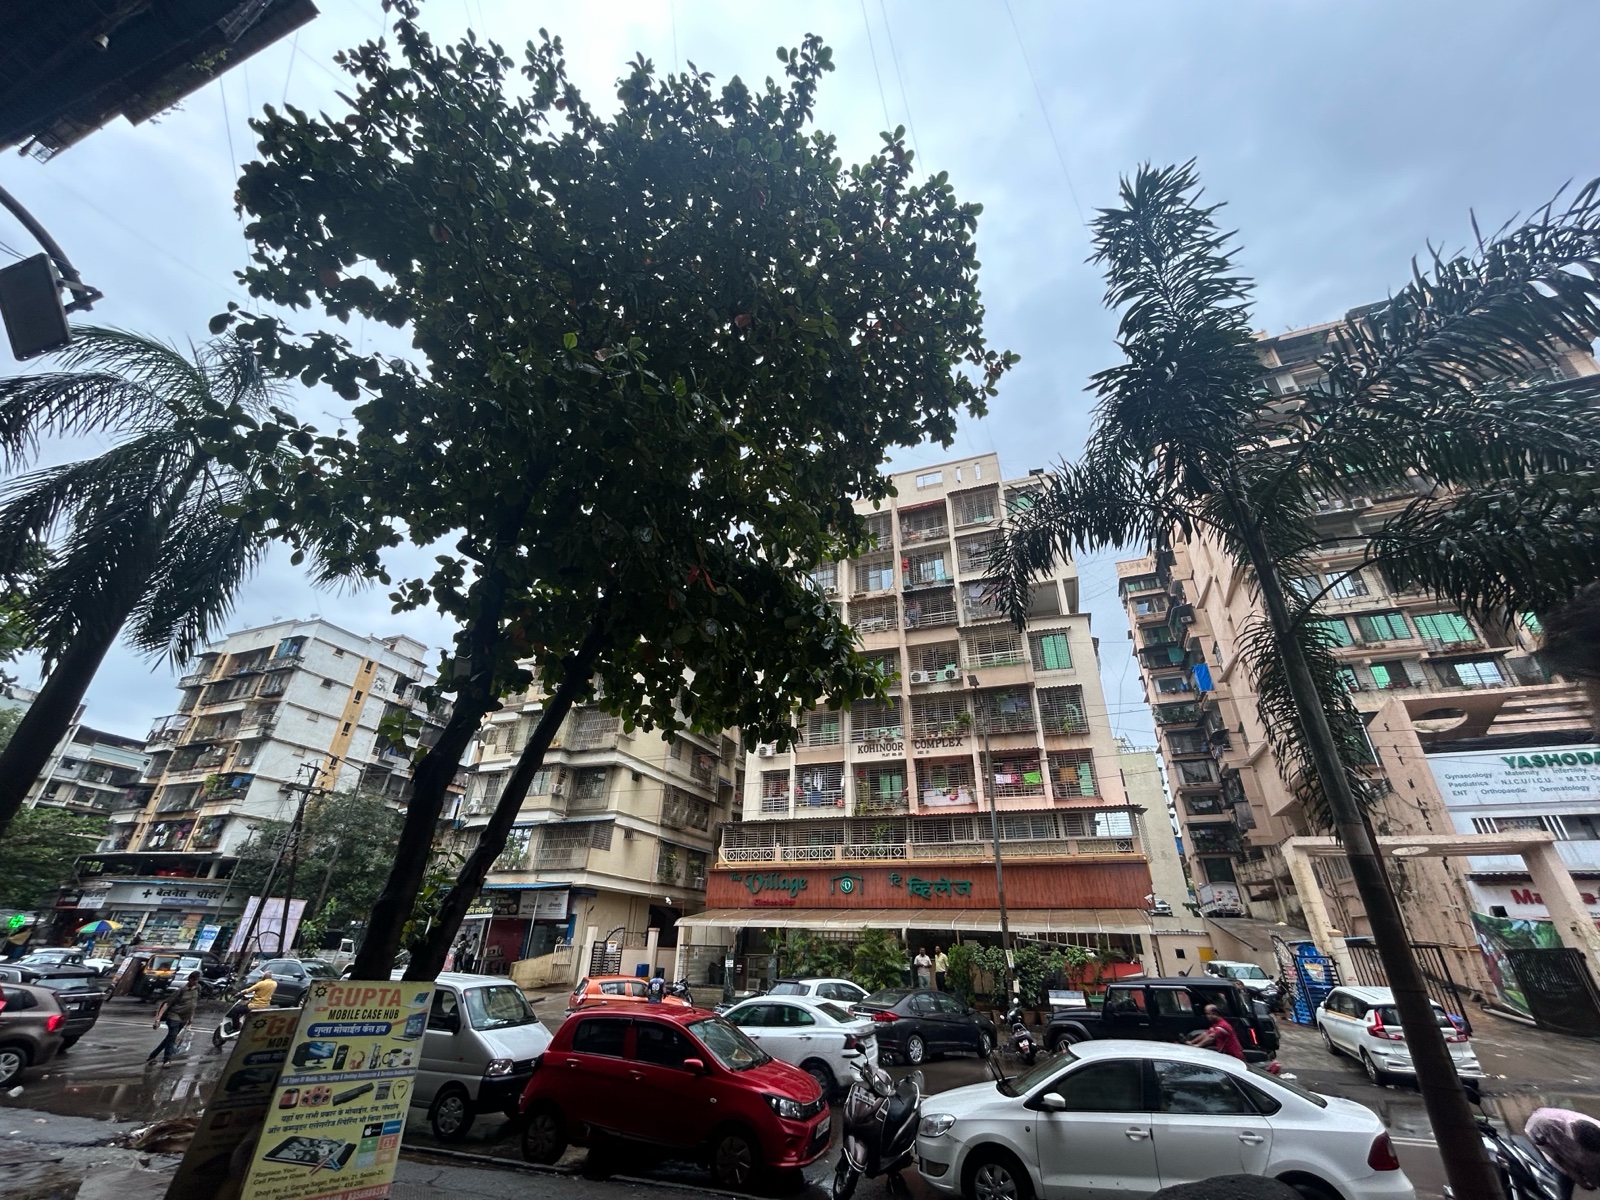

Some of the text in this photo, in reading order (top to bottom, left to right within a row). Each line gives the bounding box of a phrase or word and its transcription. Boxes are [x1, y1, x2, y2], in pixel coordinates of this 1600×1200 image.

[857, 737, 964, 754] KOHINOOR COMPLEX
[1444, 772, 1493, 782] Gynaecology
[1504, 769, 1540, 778] Maternity
[1448, 780, 1489, 789] Paediatrics
[1452, 784, 1590, 797] ENT Orthopaedic Dermatology
[742, 872, 808, 898] Village
[906, 876, 973, 900] व्हिलेज
[327, 988, 401, 1008] GUPTA
[327, 1008, 399, 1021] MOBILE CASE HUB
[314, 1026, 333, 1037] गुप्ता
[268, 1174, 289, 1183] Phone
[254, 1189, 272, 1198] Shop
